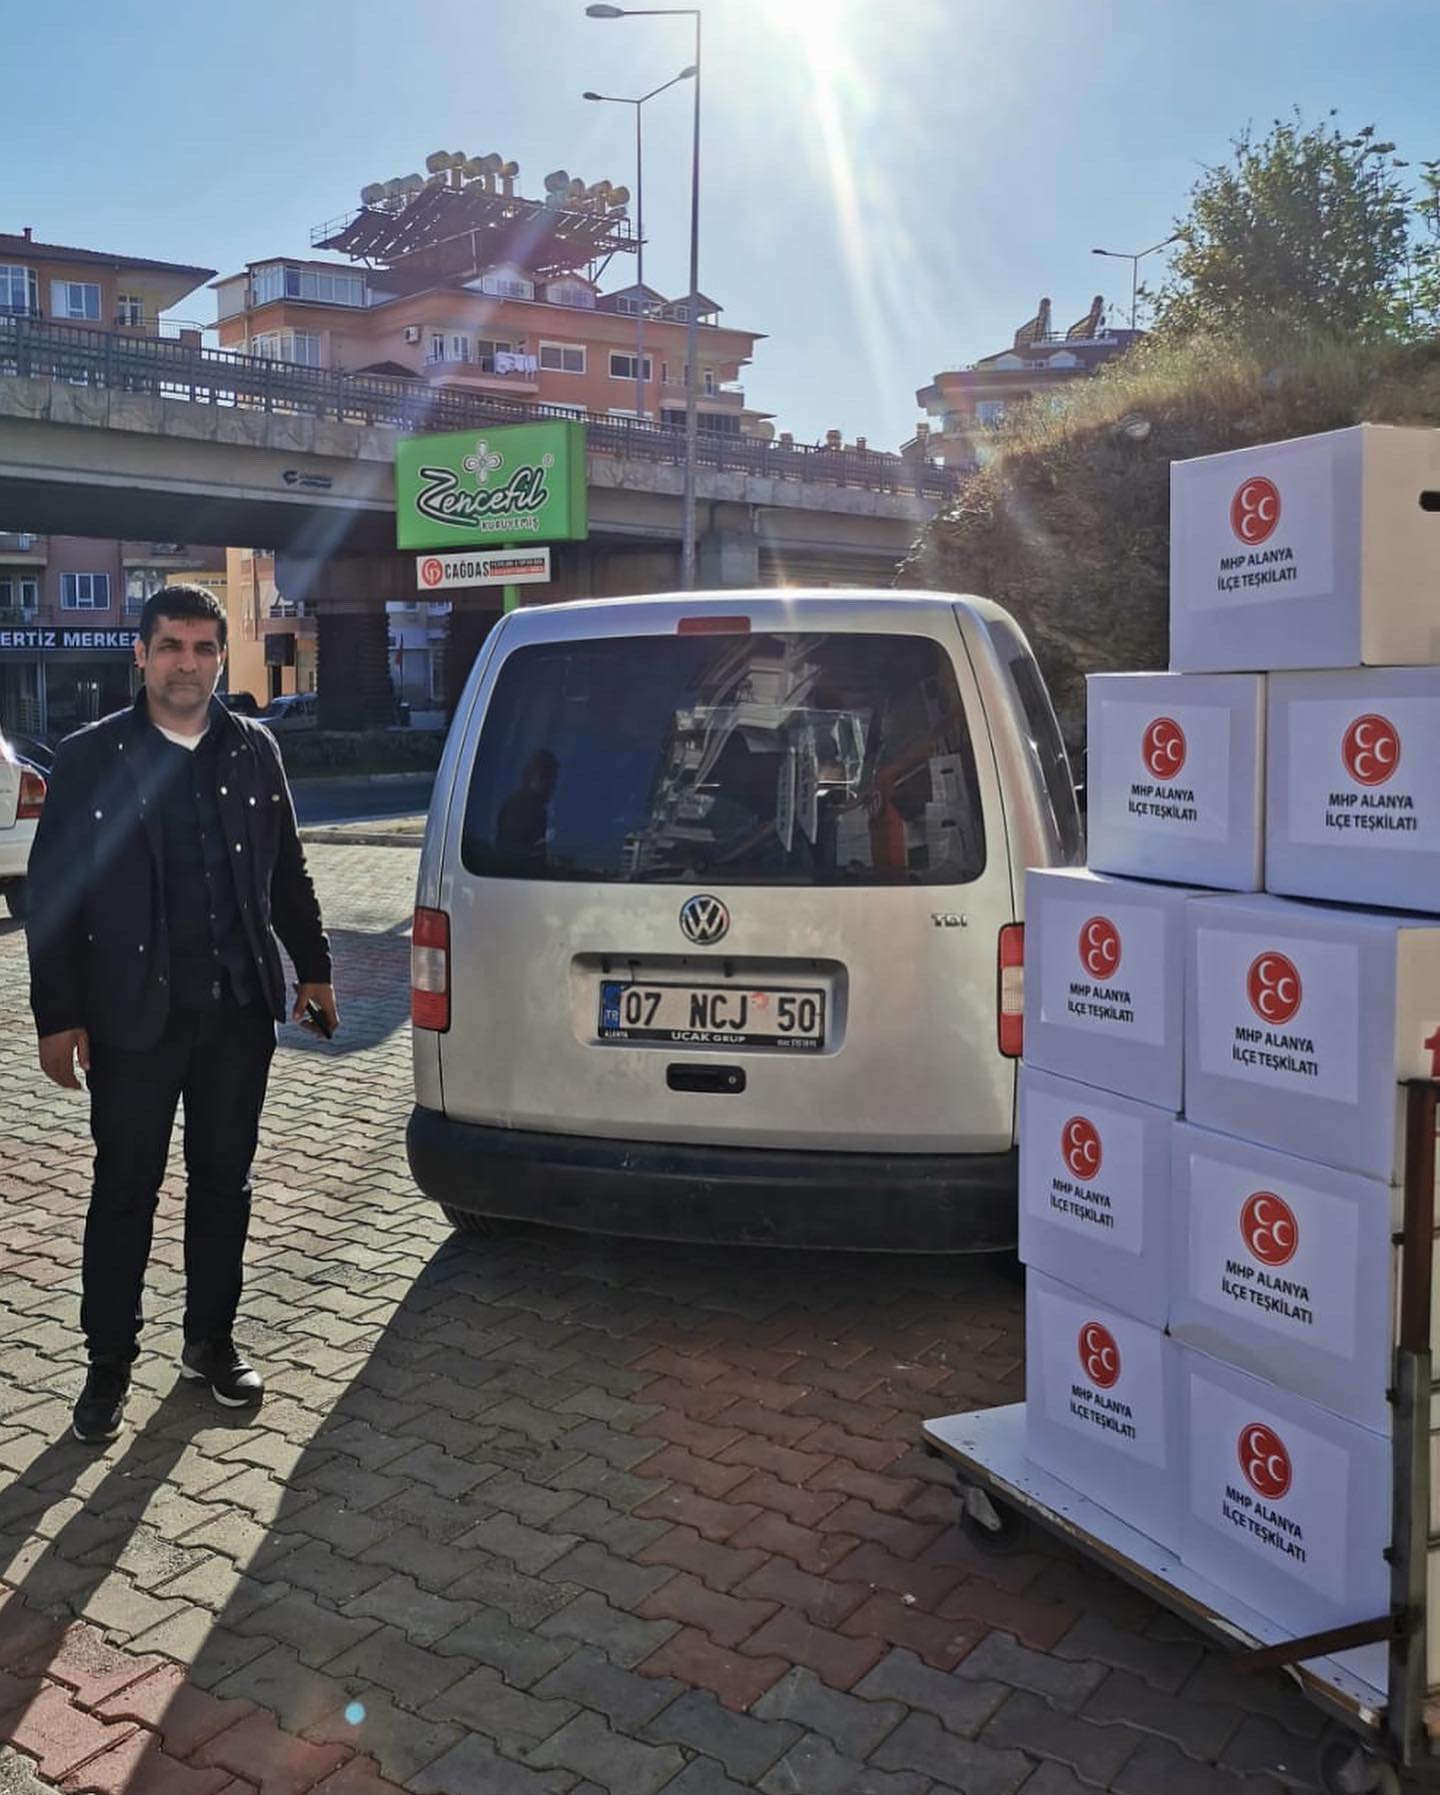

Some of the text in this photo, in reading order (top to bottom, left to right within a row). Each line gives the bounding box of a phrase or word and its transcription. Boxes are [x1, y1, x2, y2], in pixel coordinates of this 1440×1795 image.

[417, 466, 549, 527] Zencefil
[1220, 547, 1294, 571] MHP ALANYA
[1217, 567, 1297, 592] İLÇE TEŞKİLATI
[1131, 784, 1194, 802] MHP ALANYA
[1328, 793, 1414, 809] MHP ALANYA
[1128, 797, 1198, 821] İLÇE TEŞKİLATI
[1325, 811, 1417, 832] İLÇE TEŞKİLATI
[930, 912, 968, 928] TDI
[1069, 983, 1131, 1004] MHP ALANYA
[626, 991, 816, 1032] 07 NCJ 50
[1067, 999, 1134, 1023] İLÇE TEŞKİLATI
[1235, 1027, 1315, 1054] MHP ALANYA
[1232, 1044, 1319, 1076] İLÇE TEŞKİLATI
[1052, 1178, 1111, 1208] MHP ALANYA
[1050, 1193, 1114, 1229] İLÇE TEŞKİLATI
[1226, 1259, 1310, 1301] MHP ALANYA
[1221, 1276, 1313, 1324] İLÇE TEŞKİLATI
[1071, 1384, 1133, 1419] MHP ALANYA
[1070, 1399, 1136, 1440] İLÇE TEŞKİLATI
[1226, 1485, 1303, 1540] MHP ALANYA
[1222, 1501, 1307, 1563] İLÇE TEŞKİLATI
